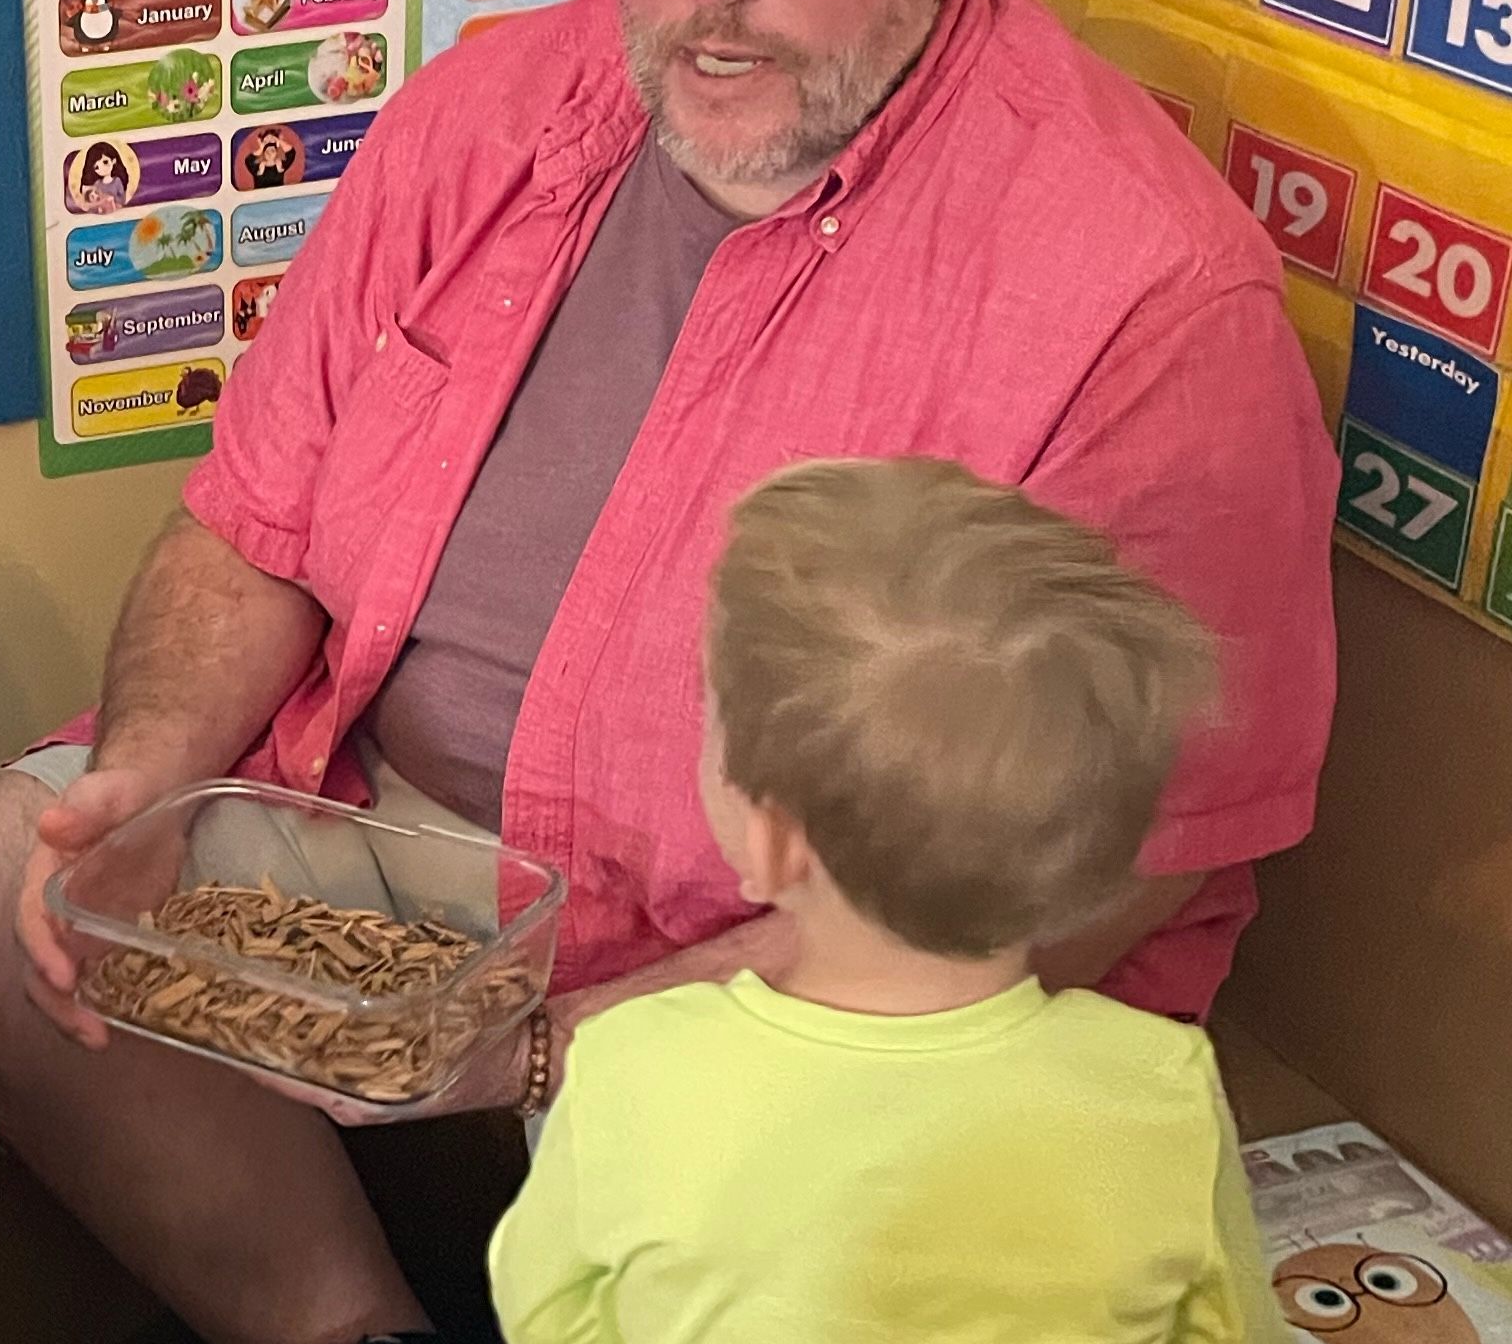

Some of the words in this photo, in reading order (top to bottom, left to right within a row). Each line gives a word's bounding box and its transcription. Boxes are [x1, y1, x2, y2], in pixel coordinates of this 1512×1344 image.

[135, 1, 214, 26] January
[67, 90, 128, 113] March
[239, 69, 286, 91] April
[173, 157, 212, 176] May
[74, 248, 114, 268] July
[238, 218, 306, 244] August
[1250, 153, 1330, 239] 19
[1381, 217, 1493, 320] 20
[122, 308, 222, 337] September
[1369, 325, 1482, 396] Yesterday
[78, 389, 173, 417] November
[1348, 450, 1460, 543] 27
